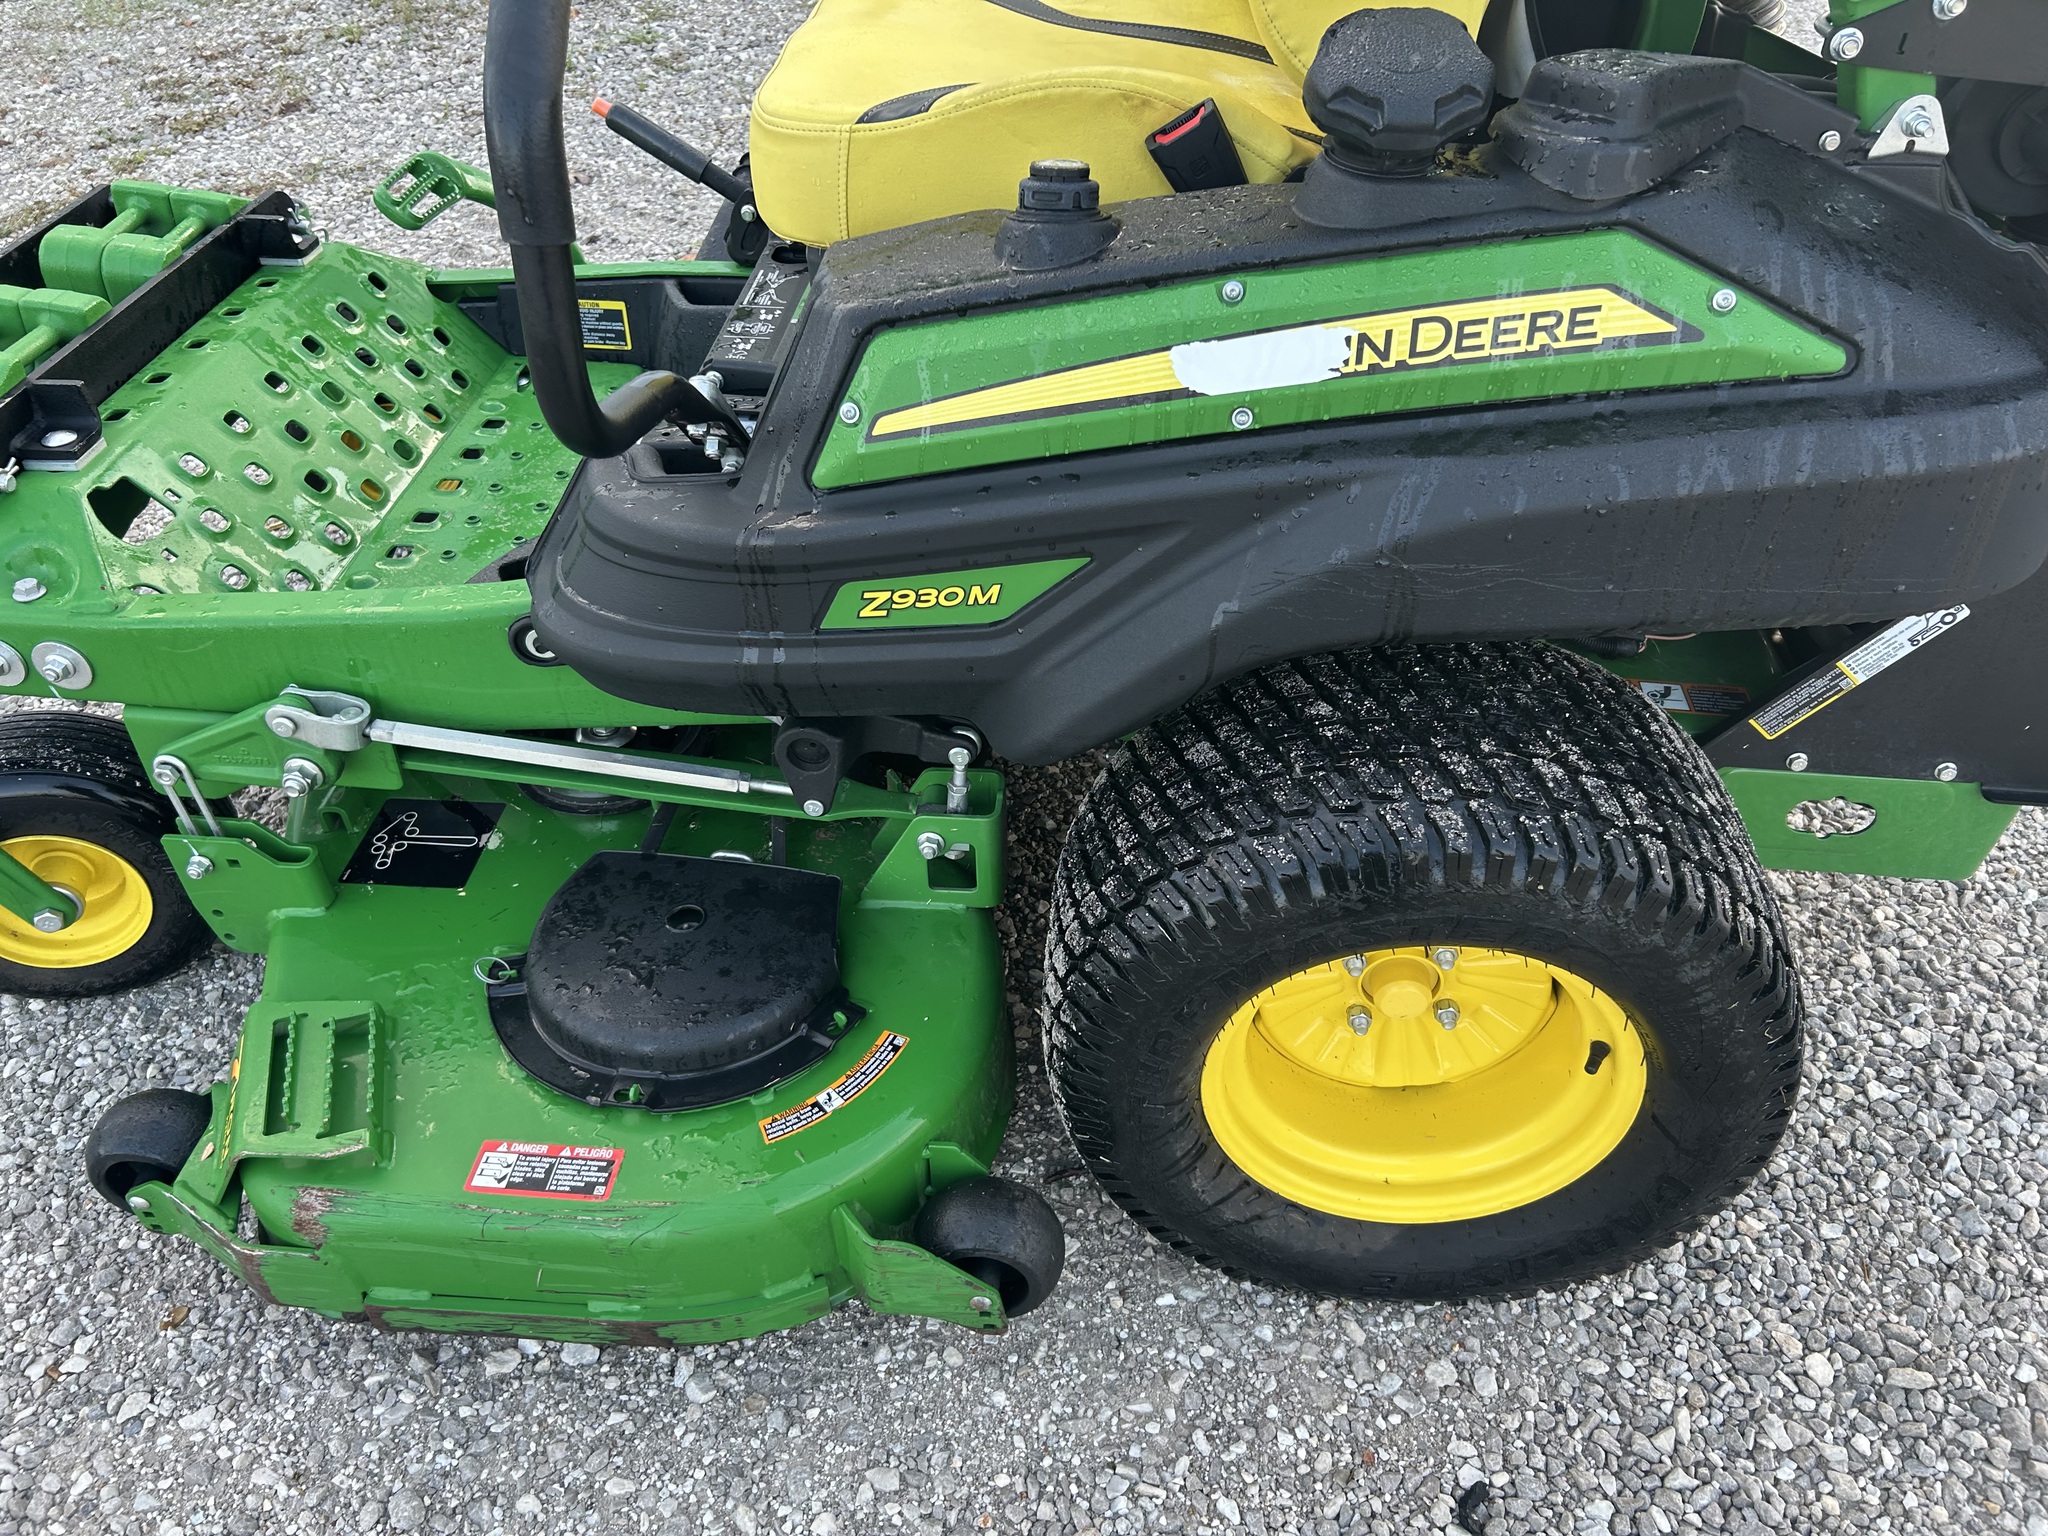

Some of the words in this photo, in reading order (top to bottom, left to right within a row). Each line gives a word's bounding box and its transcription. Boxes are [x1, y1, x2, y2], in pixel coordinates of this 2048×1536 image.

[1408, 304, 1603, 360] DEERE
[857, 583, 1003, 619] Z930M
[778, 1102, 808, 1118] WARNING
[510, 1143, 548, 1153] DANGER
[574, 1147, 613, 1158] PELIGRO
